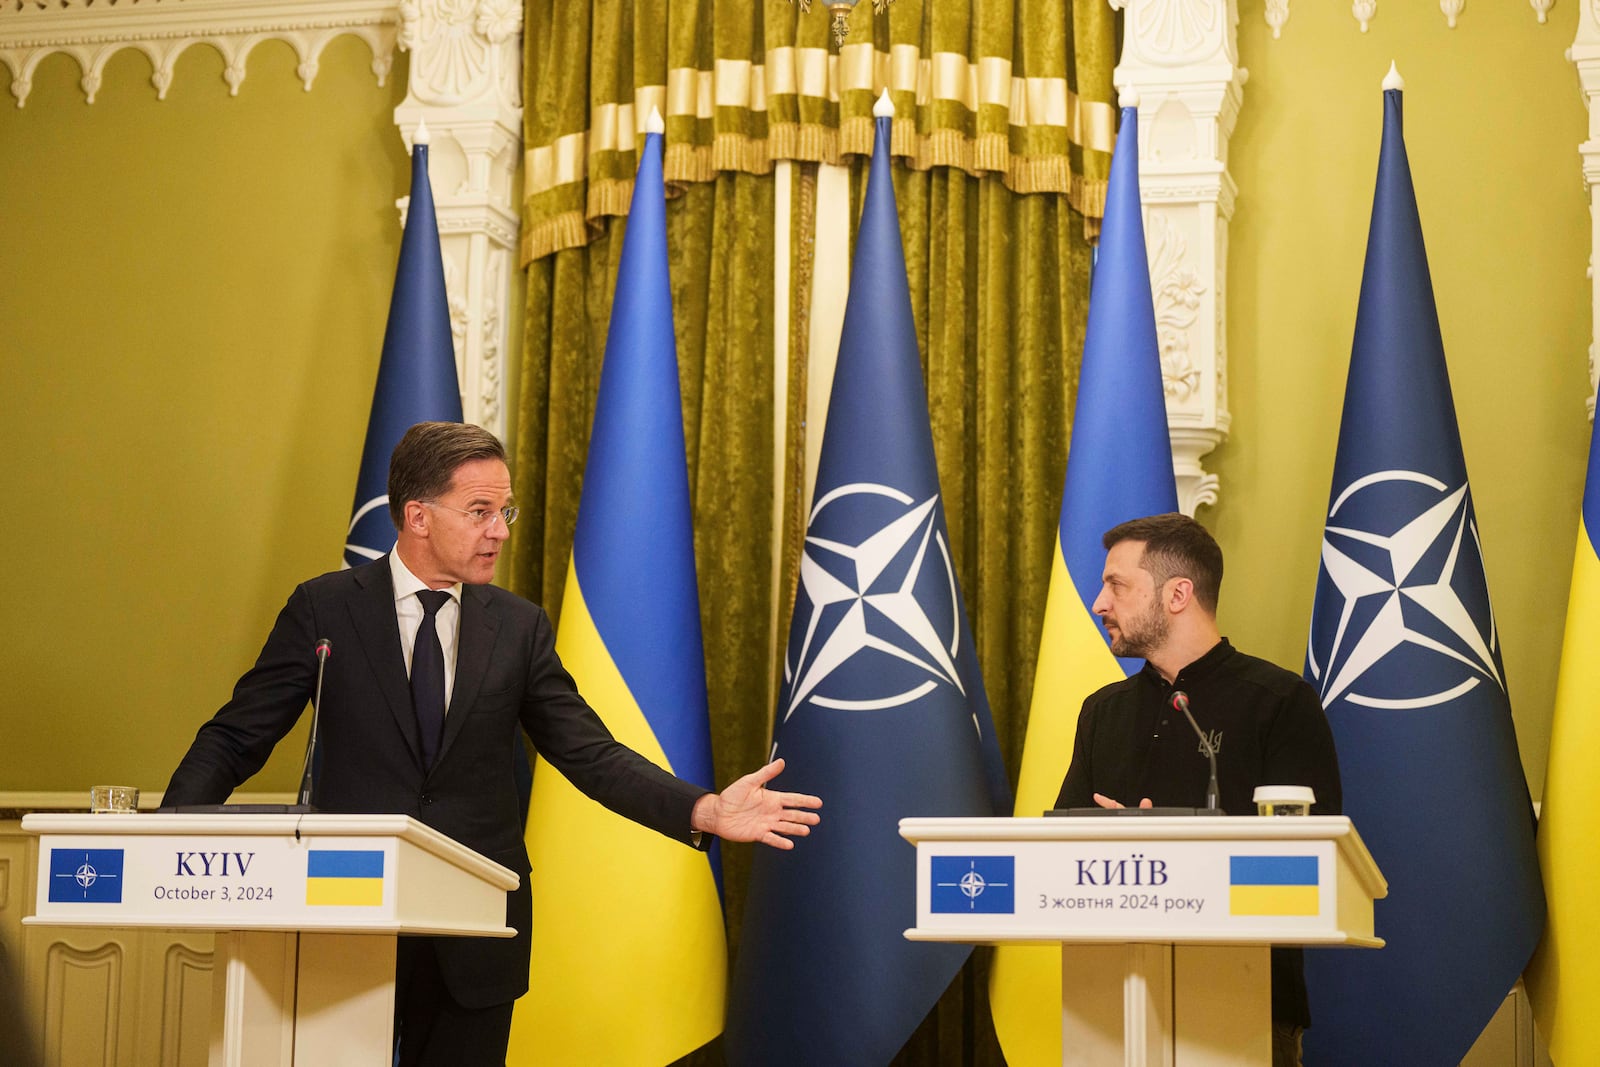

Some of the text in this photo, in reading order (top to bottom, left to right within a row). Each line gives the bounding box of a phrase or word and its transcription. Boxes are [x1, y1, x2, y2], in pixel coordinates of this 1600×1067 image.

[175, 851, 256, 877] KYIV
[1075, 854, 1169, 886] КИЇВ
[153, 885, 274, 902] October 3, 2024
[1039, 895, 1205, 914] 3 жовтня 2024 року
